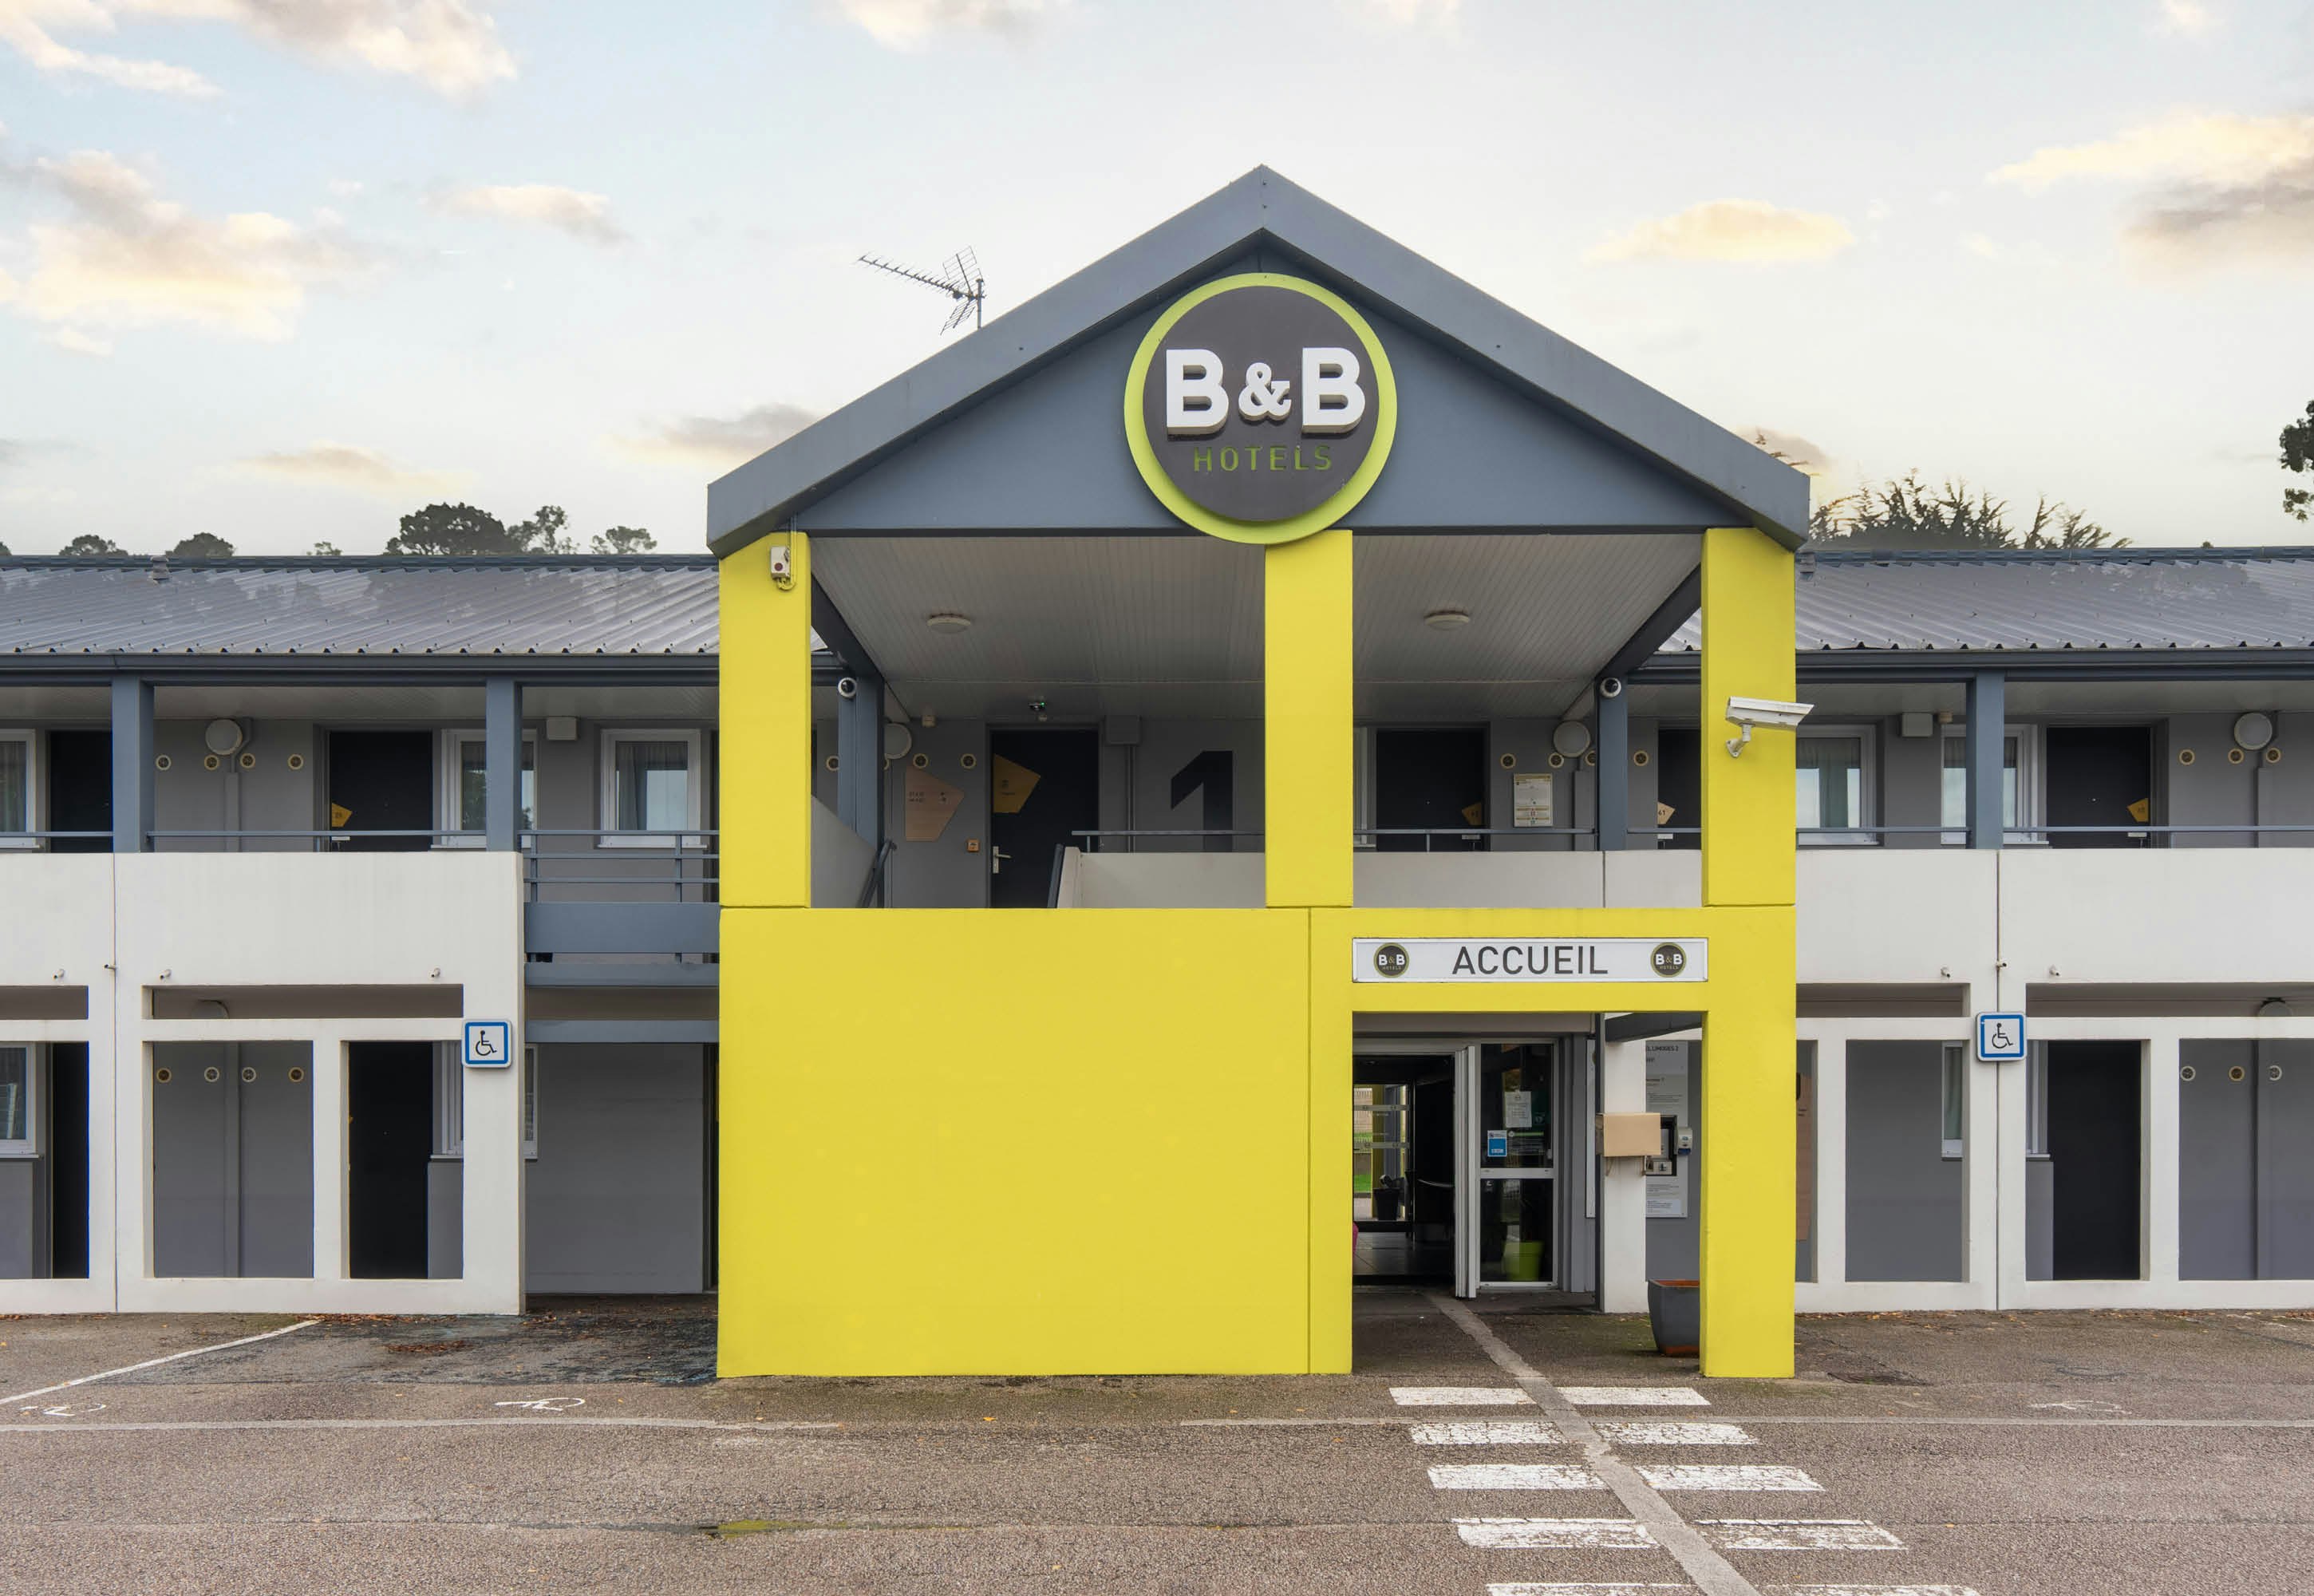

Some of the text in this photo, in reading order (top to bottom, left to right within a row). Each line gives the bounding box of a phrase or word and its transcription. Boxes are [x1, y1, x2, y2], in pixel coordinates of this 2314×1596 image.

[1166, 347, 1366, 434] B&B
[1193, 445, 1332, 472] HOTELS
[1171, 750, 1233, 852] 1
[1451, 946, 1609, 975] ACCUEIL
